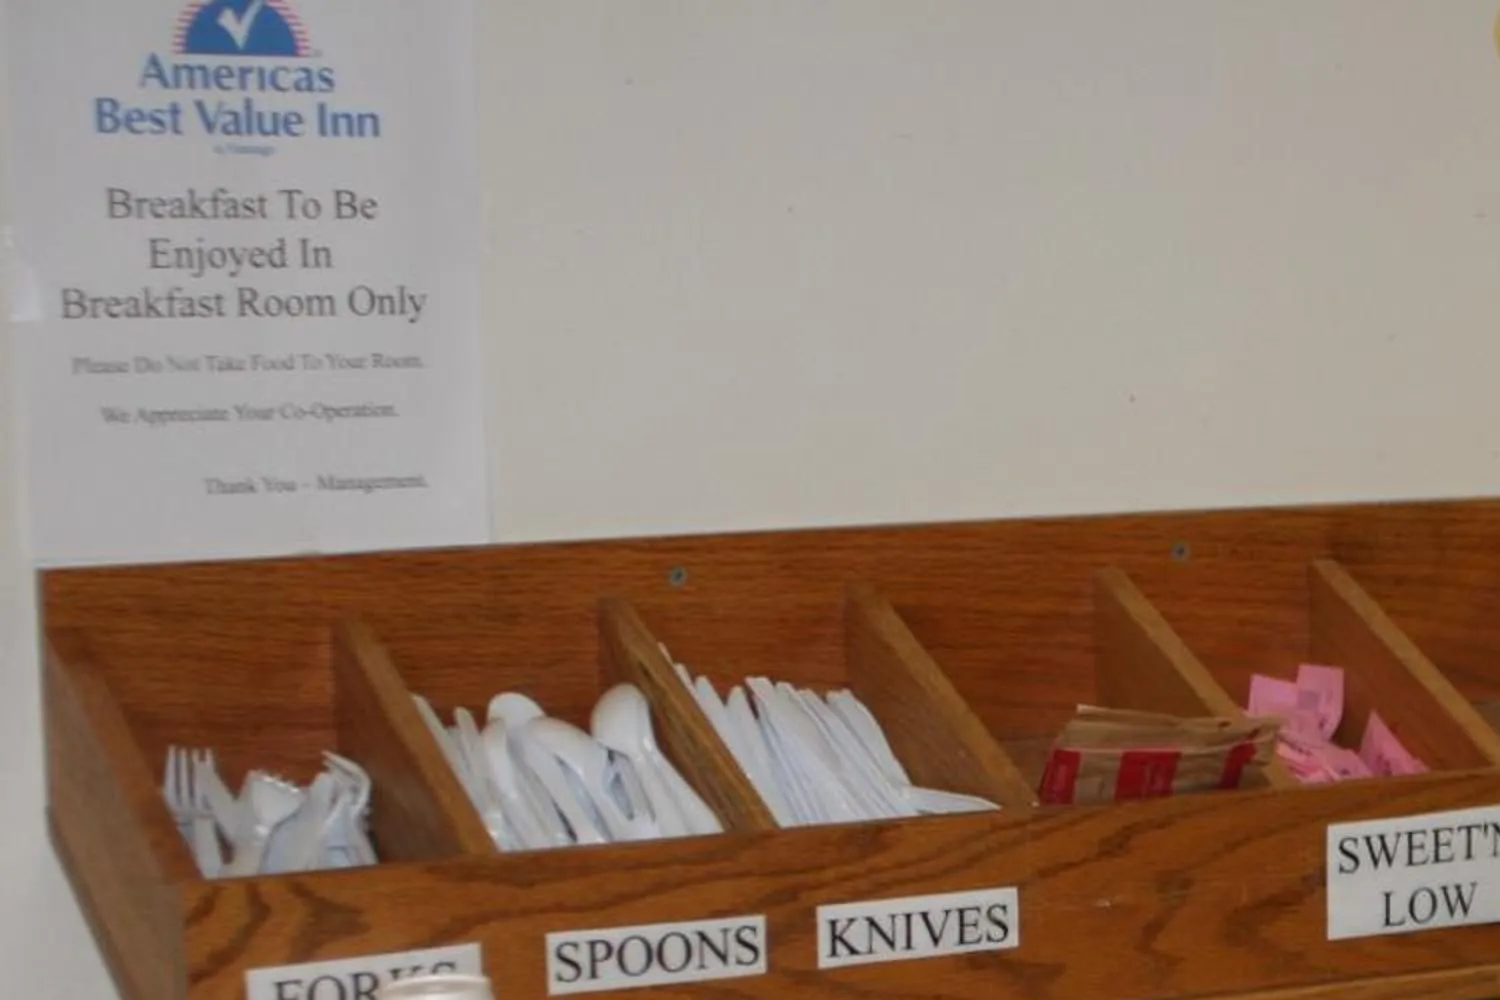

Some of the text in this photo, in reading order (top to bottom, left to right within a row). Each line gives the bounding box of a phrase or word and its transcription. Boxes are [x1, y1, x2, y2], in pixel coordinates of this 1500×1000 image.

[140, 53, 336, 93] Americas
[94, 98, 381, 138] Best Value Inn
[107, 188, 379, 220] Breakfast To Be
[149, 238, 333, 278] Enjoyed In
[61, 285, 428, 323] Breakfast Room Only
[71, 356, 130, 376] Please
[133, 355, 163, 375] Do
[165, 354, 200, 373] Not
[204, 354, 247, 373] Take
[250, 352, 295, 371] Food
[301, 353, 323, 370] To
[325, 352, 367, 370] Your
[101, 406, 132, 424] We
[137, 405, 231, 426] Appreciate
[233, 403, 275, 422] Your
[205, 477, 258, 495] Thank
[261, 476, 298, 493] You
[1383, 882, 1477, 928] LOW
[826, 902, 1010, 960] KNIVES
[555, 924, 762, 984] SPOONS
